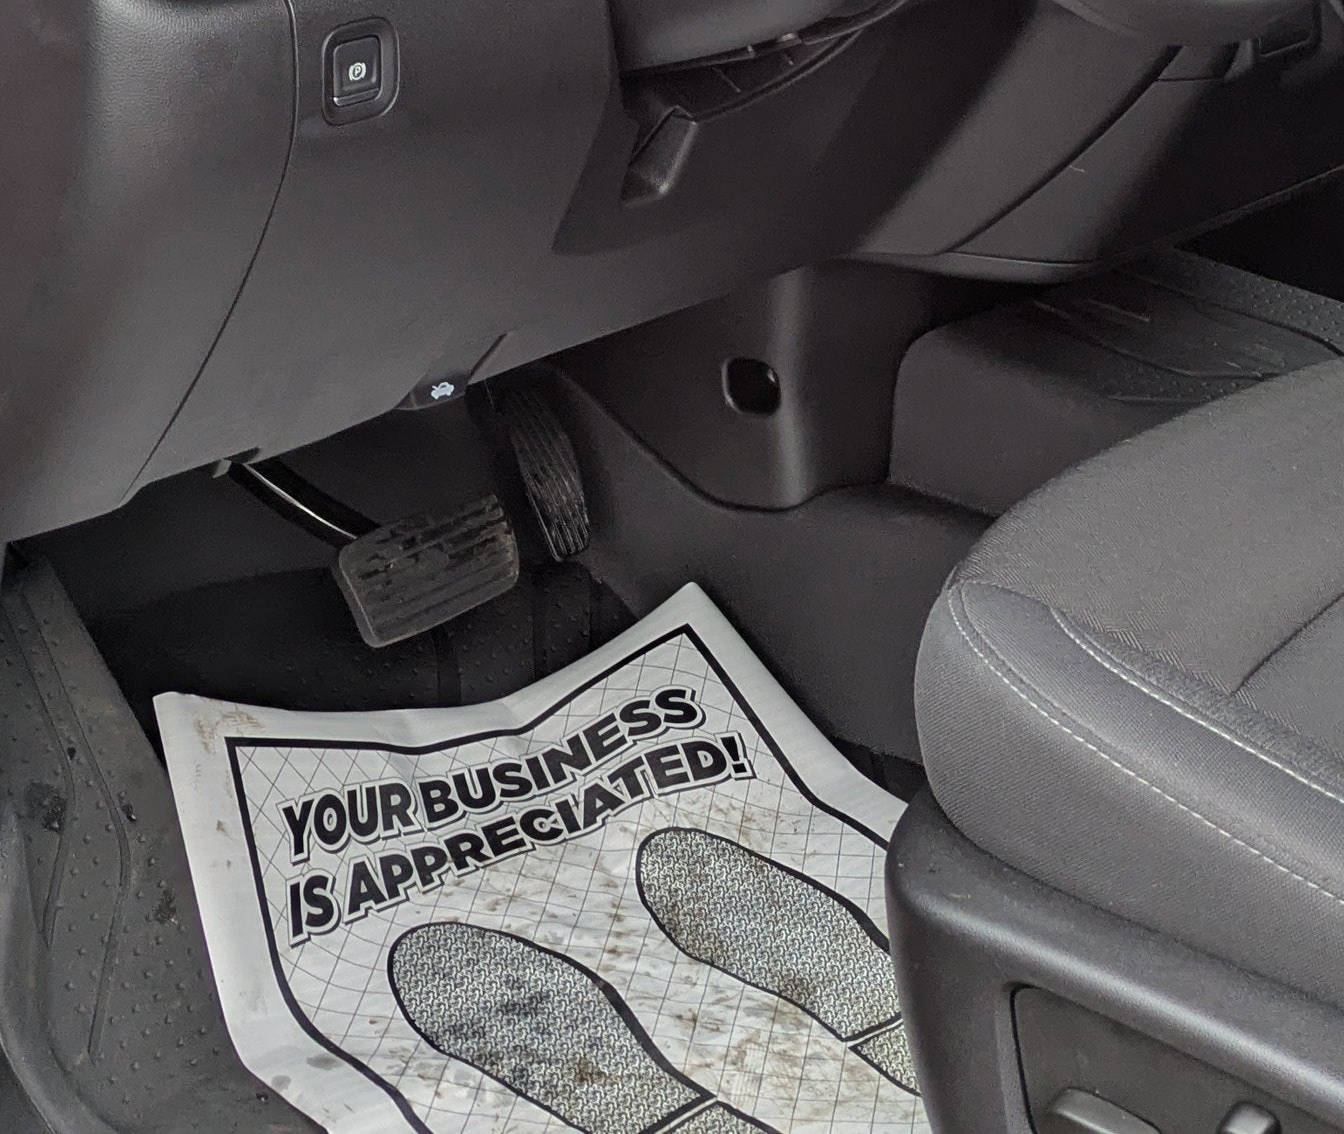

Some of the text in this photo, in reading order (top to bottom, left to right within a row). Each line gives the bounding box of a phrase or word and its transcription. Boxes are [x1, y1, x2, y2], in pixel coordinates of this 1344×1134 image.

[281, 687, 702, 861] YOUR BUSINESS
[287, 734, 755, 943] IS APPRECIATED!
